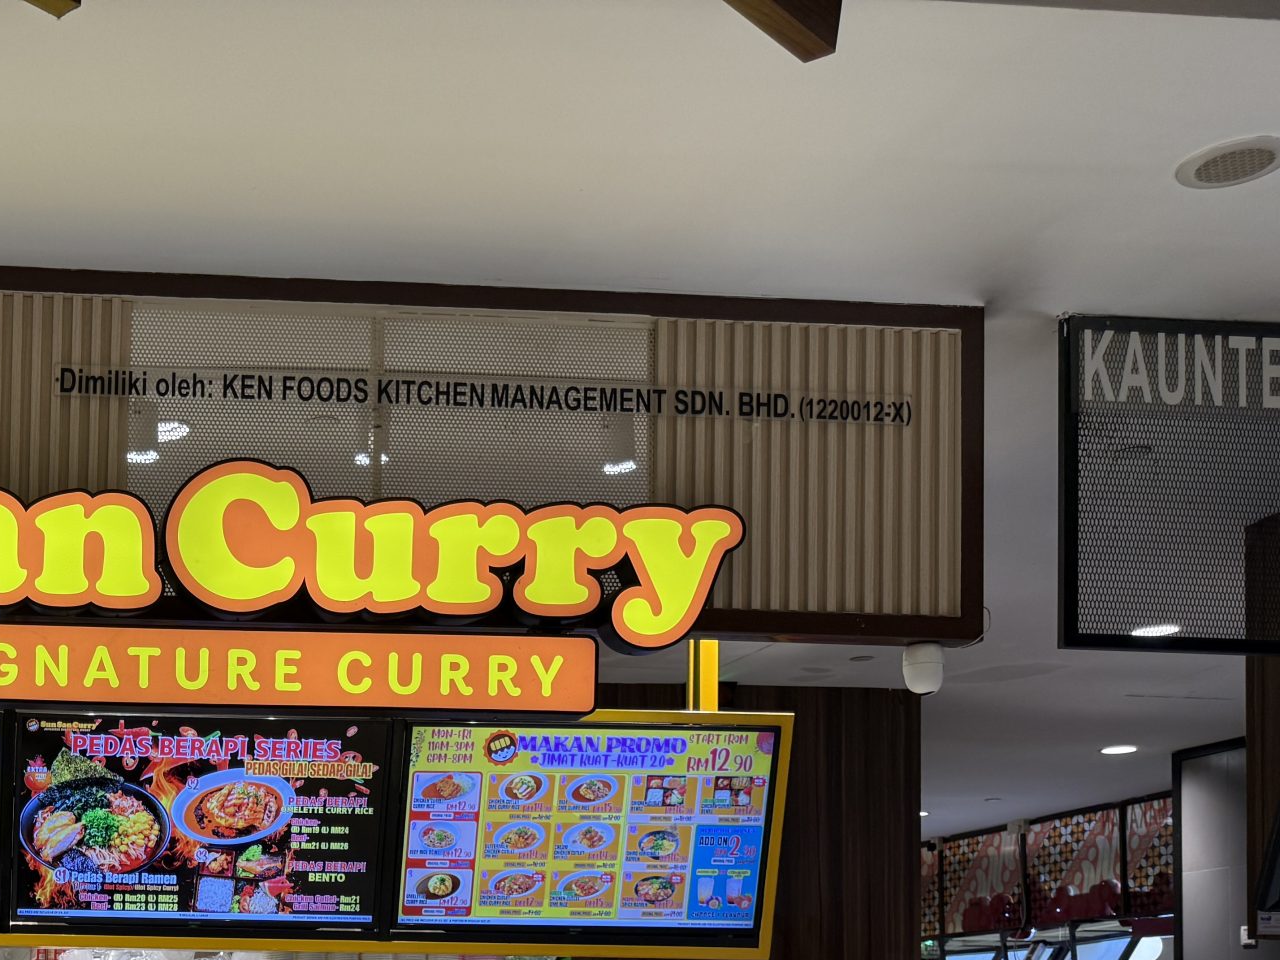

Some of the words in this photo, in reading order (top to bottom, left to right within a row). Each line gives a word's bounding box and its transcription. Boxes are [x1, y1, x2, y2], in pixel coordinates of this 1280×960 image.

[59, 366, 148, 398] Dimiliki
[155, 372, 215, 400] oleh:
[222, 373, 273, 401] KEN
[281, 375, 369, 403] FOODS
[376, 377, 485, 408] KITCHEN
[491, 382, 667, 415] MANAGEMENT
[673, 389, 731, 416] SDN.
[738, 391, 796, 419] BHD.
[799, 395, 913, 427] (1220012-X)
[175, 470, 733, 639] Curry
[336, 648, 566, 701] CURRY
[431, 728, 472, 740] MON-FRI
[688, 733, 722, 745] START
[724, 734, 749, 746] FROM
[70, 733, 153, 758] PEDAS
[158, 735, 250, 760] BERAPI
[254, 738, 342, 761] SERIES
[427, 741, 475, 751] 11AM-3PM
[517, 735, 600, 754] MAKAN
[605, 736, 687, 755] PROMO
[426, 754, 473, 764] 6PM-8PM
[538, 754, 576, 767] JIMAT
[579, 754, 647, 767] KUAT-KUAT
[244, 760, 281, 778] PEDAS
[281, 761, 309, 778] GILA!
[309, 761, 345, 778] SEDAP
[345, 762, 373, 779] GILA!
[699, 836, 715, 847] ADD
[717, 836, 729, 847] ON
[71, 871, 103, 883] Pedas
[105, 872, 139, 885] Berapi
[141, 872, 177, 884] Ramen
[308, 872, 346, 882] BENTO
